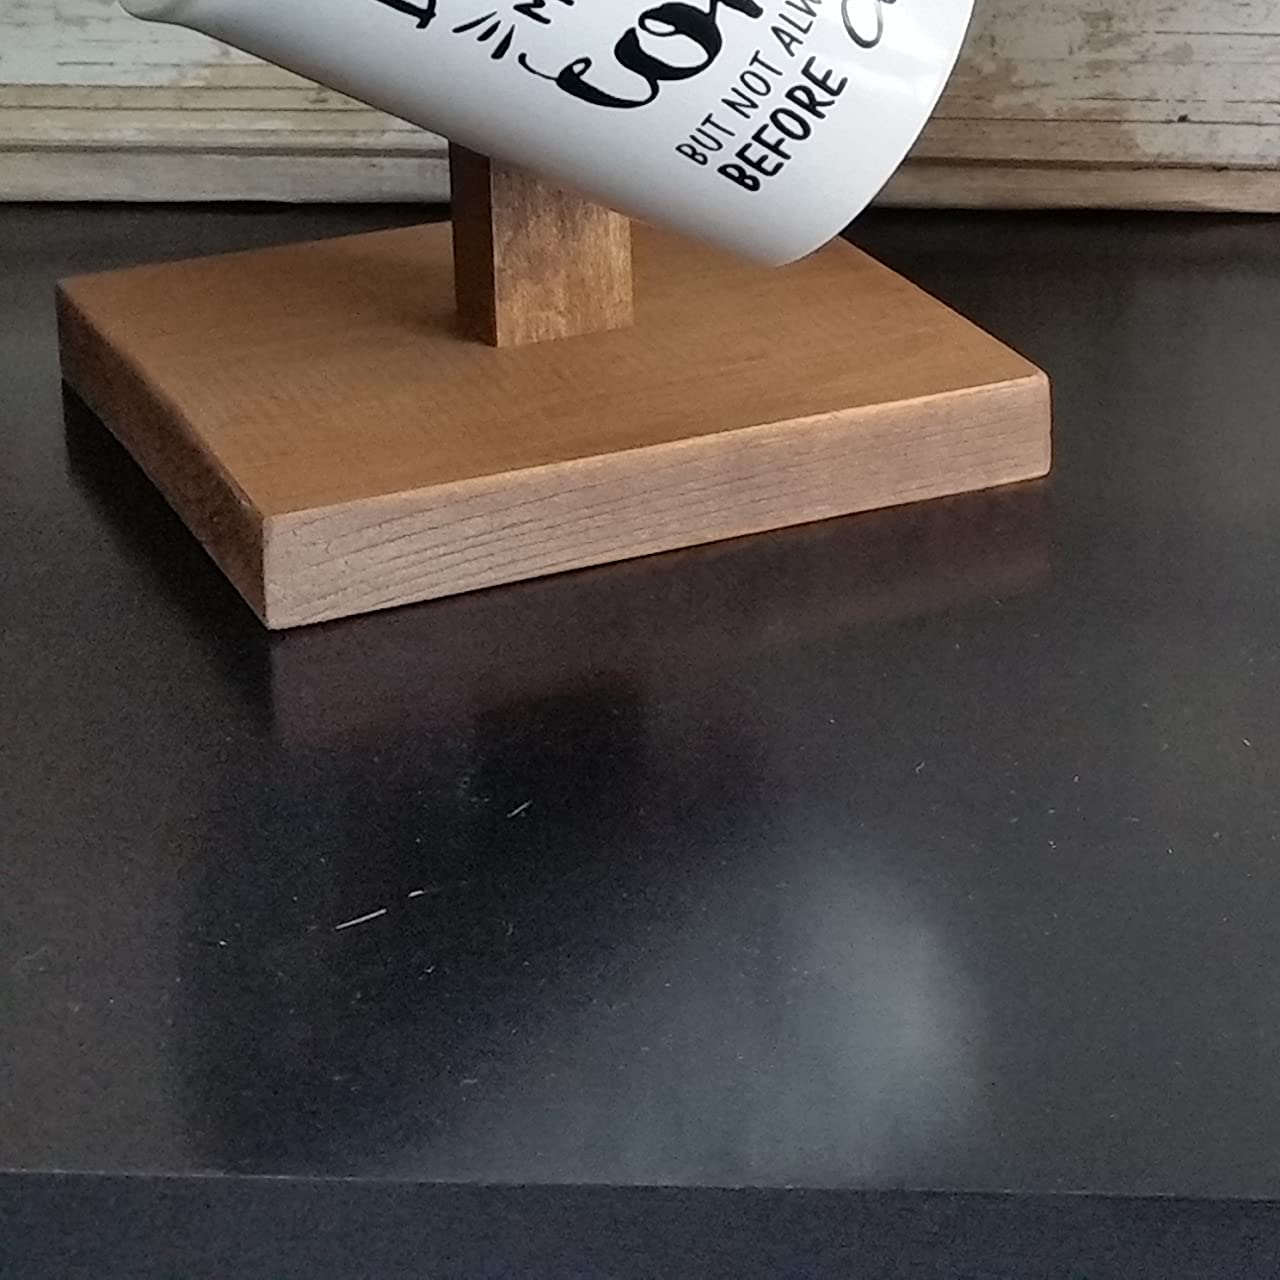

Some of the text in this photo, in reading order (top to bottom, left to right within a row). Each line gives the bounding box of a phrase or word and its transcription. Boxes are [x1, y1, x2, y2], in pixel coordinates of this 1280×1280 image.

[675, 113, 735, 166] BUT
[721, 50, 783, 118] NOT
[717, 56, 848, 192] BEFORE
